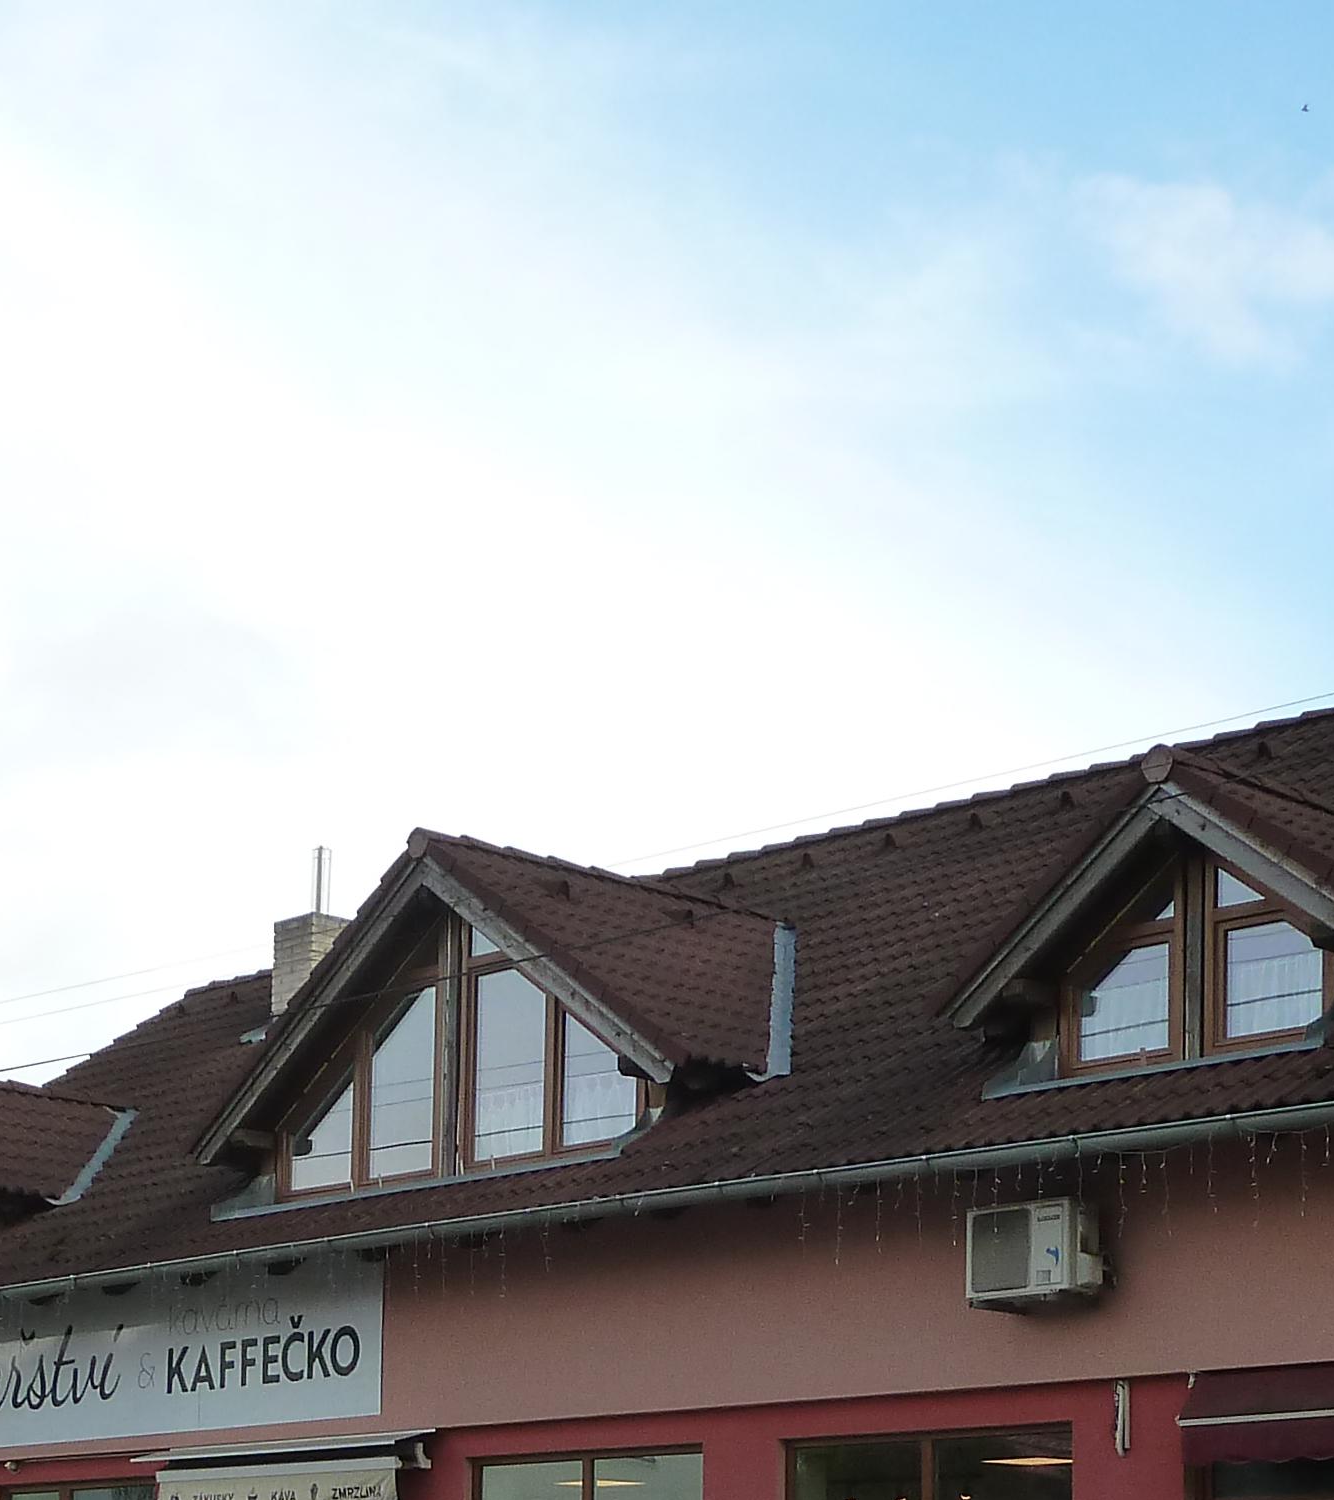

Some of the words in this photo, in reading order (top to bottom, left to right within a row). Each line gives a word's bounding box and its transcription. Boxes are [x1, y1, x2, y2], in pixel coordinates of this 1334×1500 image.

[138, 1352, 155, 1389] &
[166, 1315, 361, 1394] KAFFEČKO
[331, 1485, 382, 1500] ZMRZLINA
